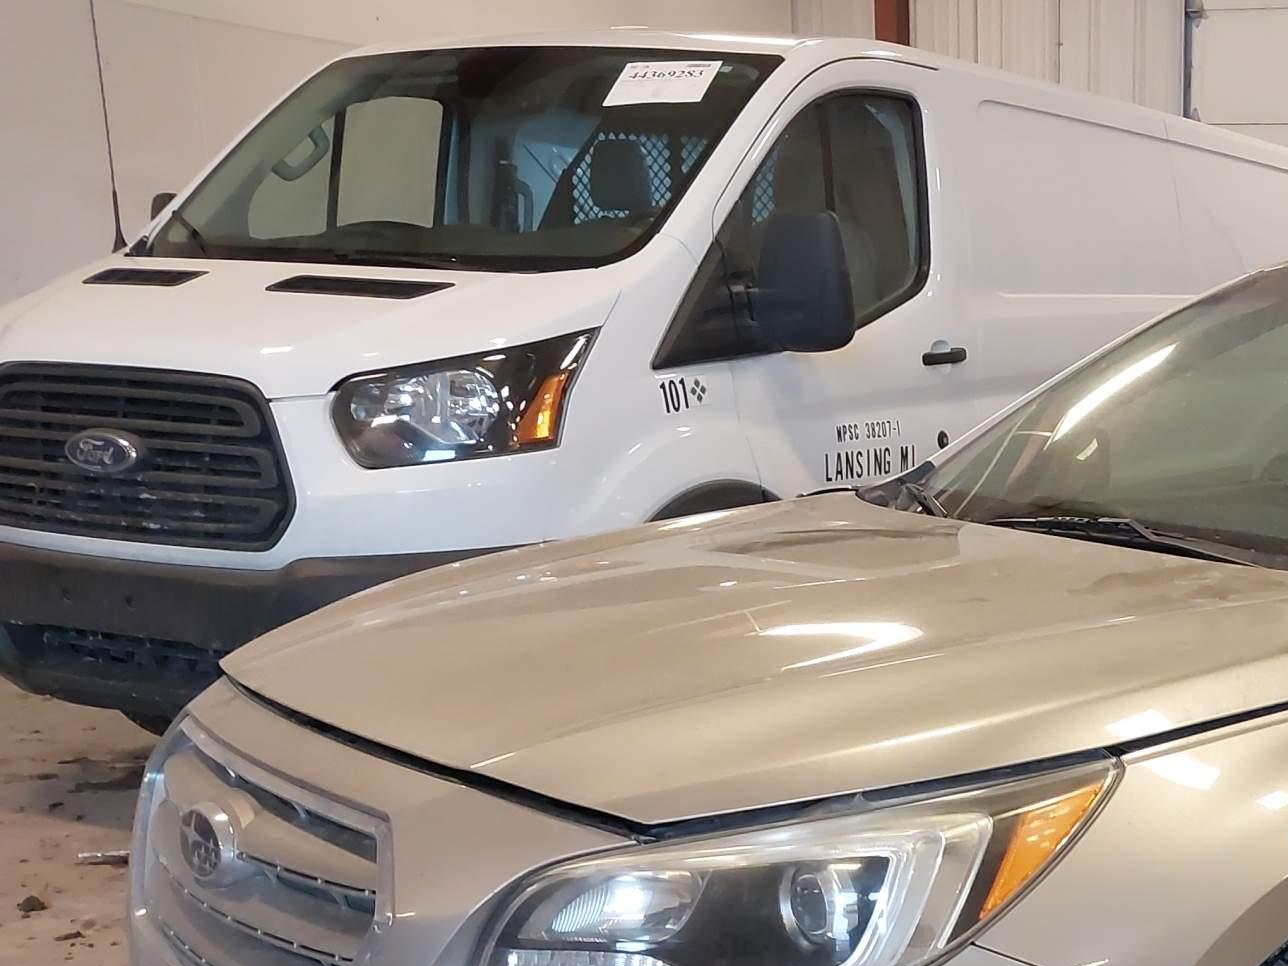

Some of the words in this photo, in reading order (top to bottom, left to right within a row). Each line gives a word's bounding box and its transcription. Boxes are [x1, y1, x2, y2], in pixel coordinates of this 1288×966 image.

[659, 377, 690, 414] 101
[865, 420, 901, 440] 38207-1
[77, 438, 115, 465] Ford
[825, 447, 891, 482] LANSING
[900, 445, 915, 473] MI
